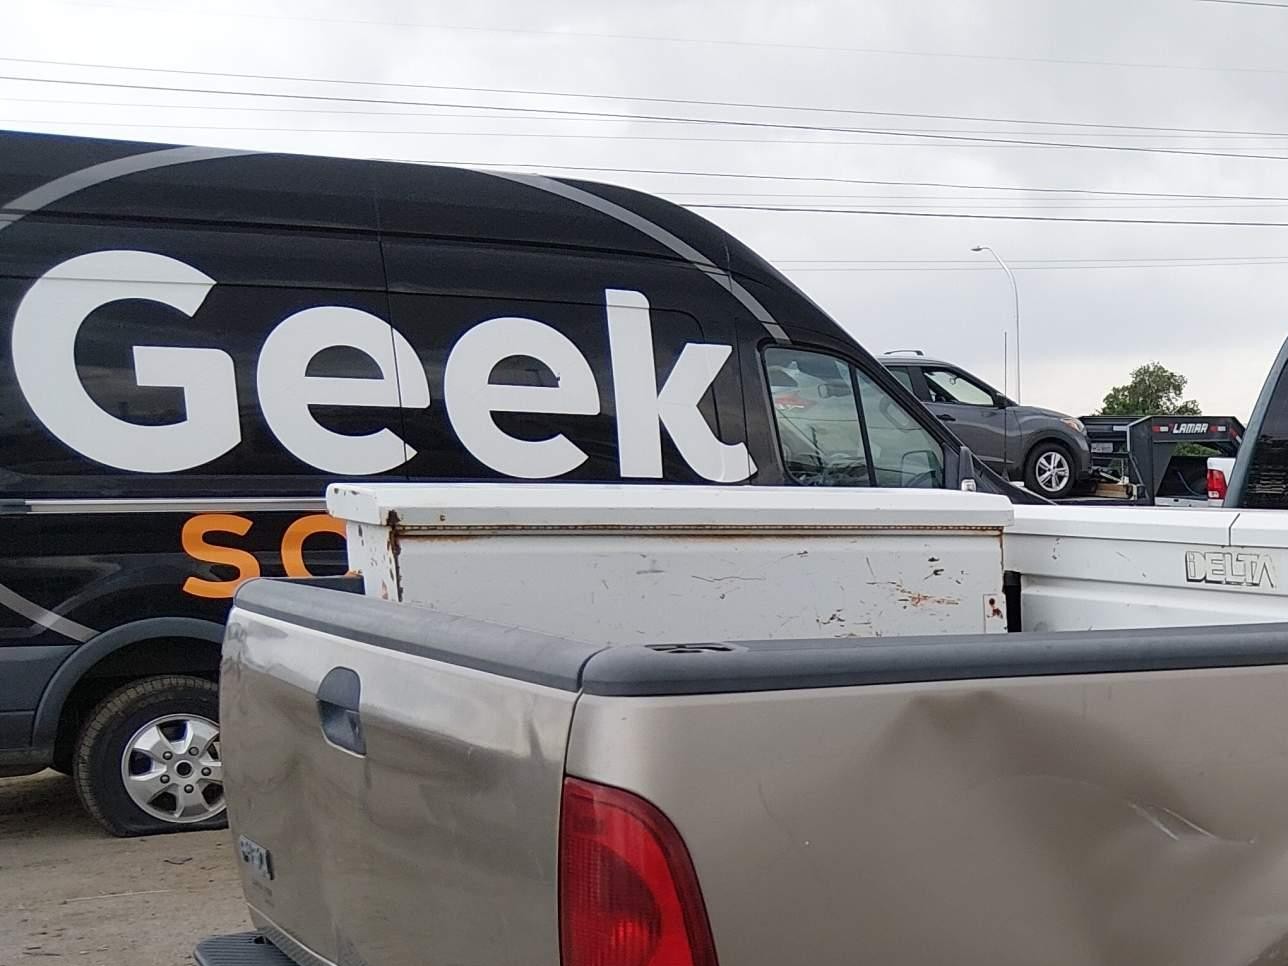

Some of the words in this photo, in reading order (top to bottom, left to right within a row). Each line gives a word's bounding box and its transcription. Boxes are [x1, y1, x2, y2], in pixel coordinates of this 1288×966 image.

[11, 249, 759, 484] Geek
[1172, 423, 1209, 434] LAMAR
[1185, 550, 1276, 588] DELTA
